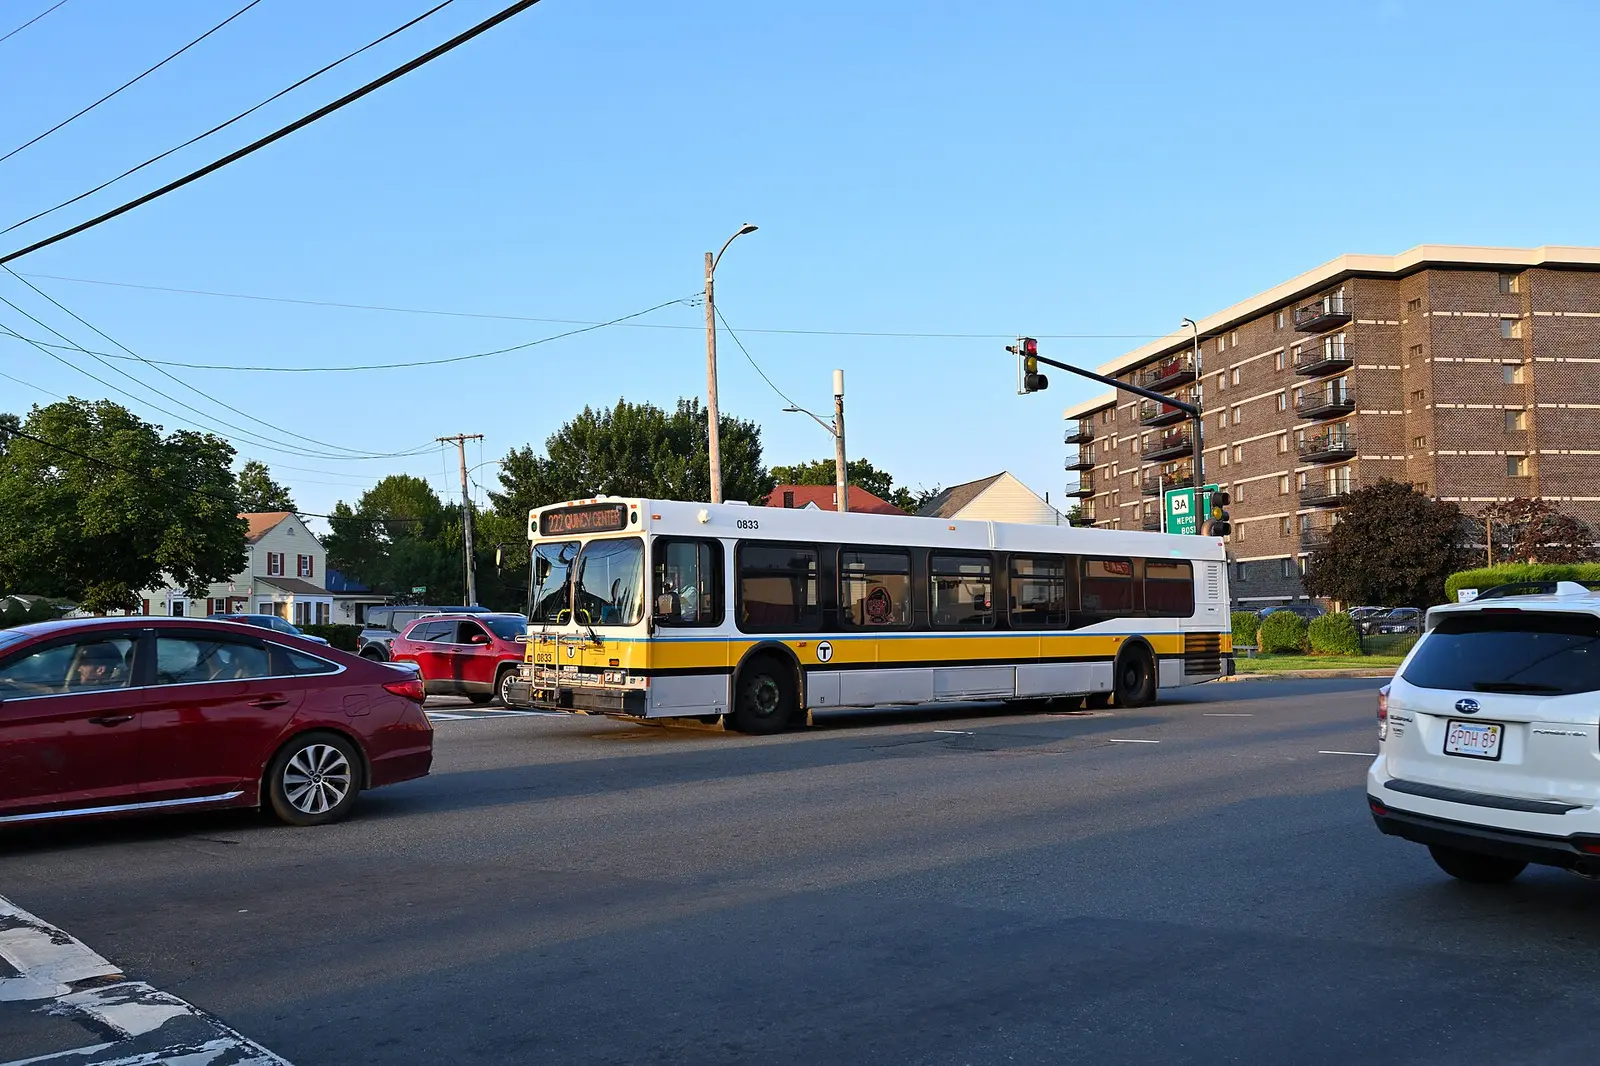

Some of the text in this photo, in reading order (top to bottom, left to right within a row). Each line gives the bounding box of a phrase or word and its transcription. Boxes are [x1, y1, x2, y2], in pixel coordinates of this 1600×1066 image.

[1174, 499, 1187, 510] 3A
[548, 509, 621, 532] 222 QUINCY CENTER
[736, 519, 759, 529] 0833
[536, 653, 552, 662] 0833
[819, 646, 830, 660] T
[1450, 729, 1479, 747] 6PDH
[1481, 732, 1496, 748] 89
